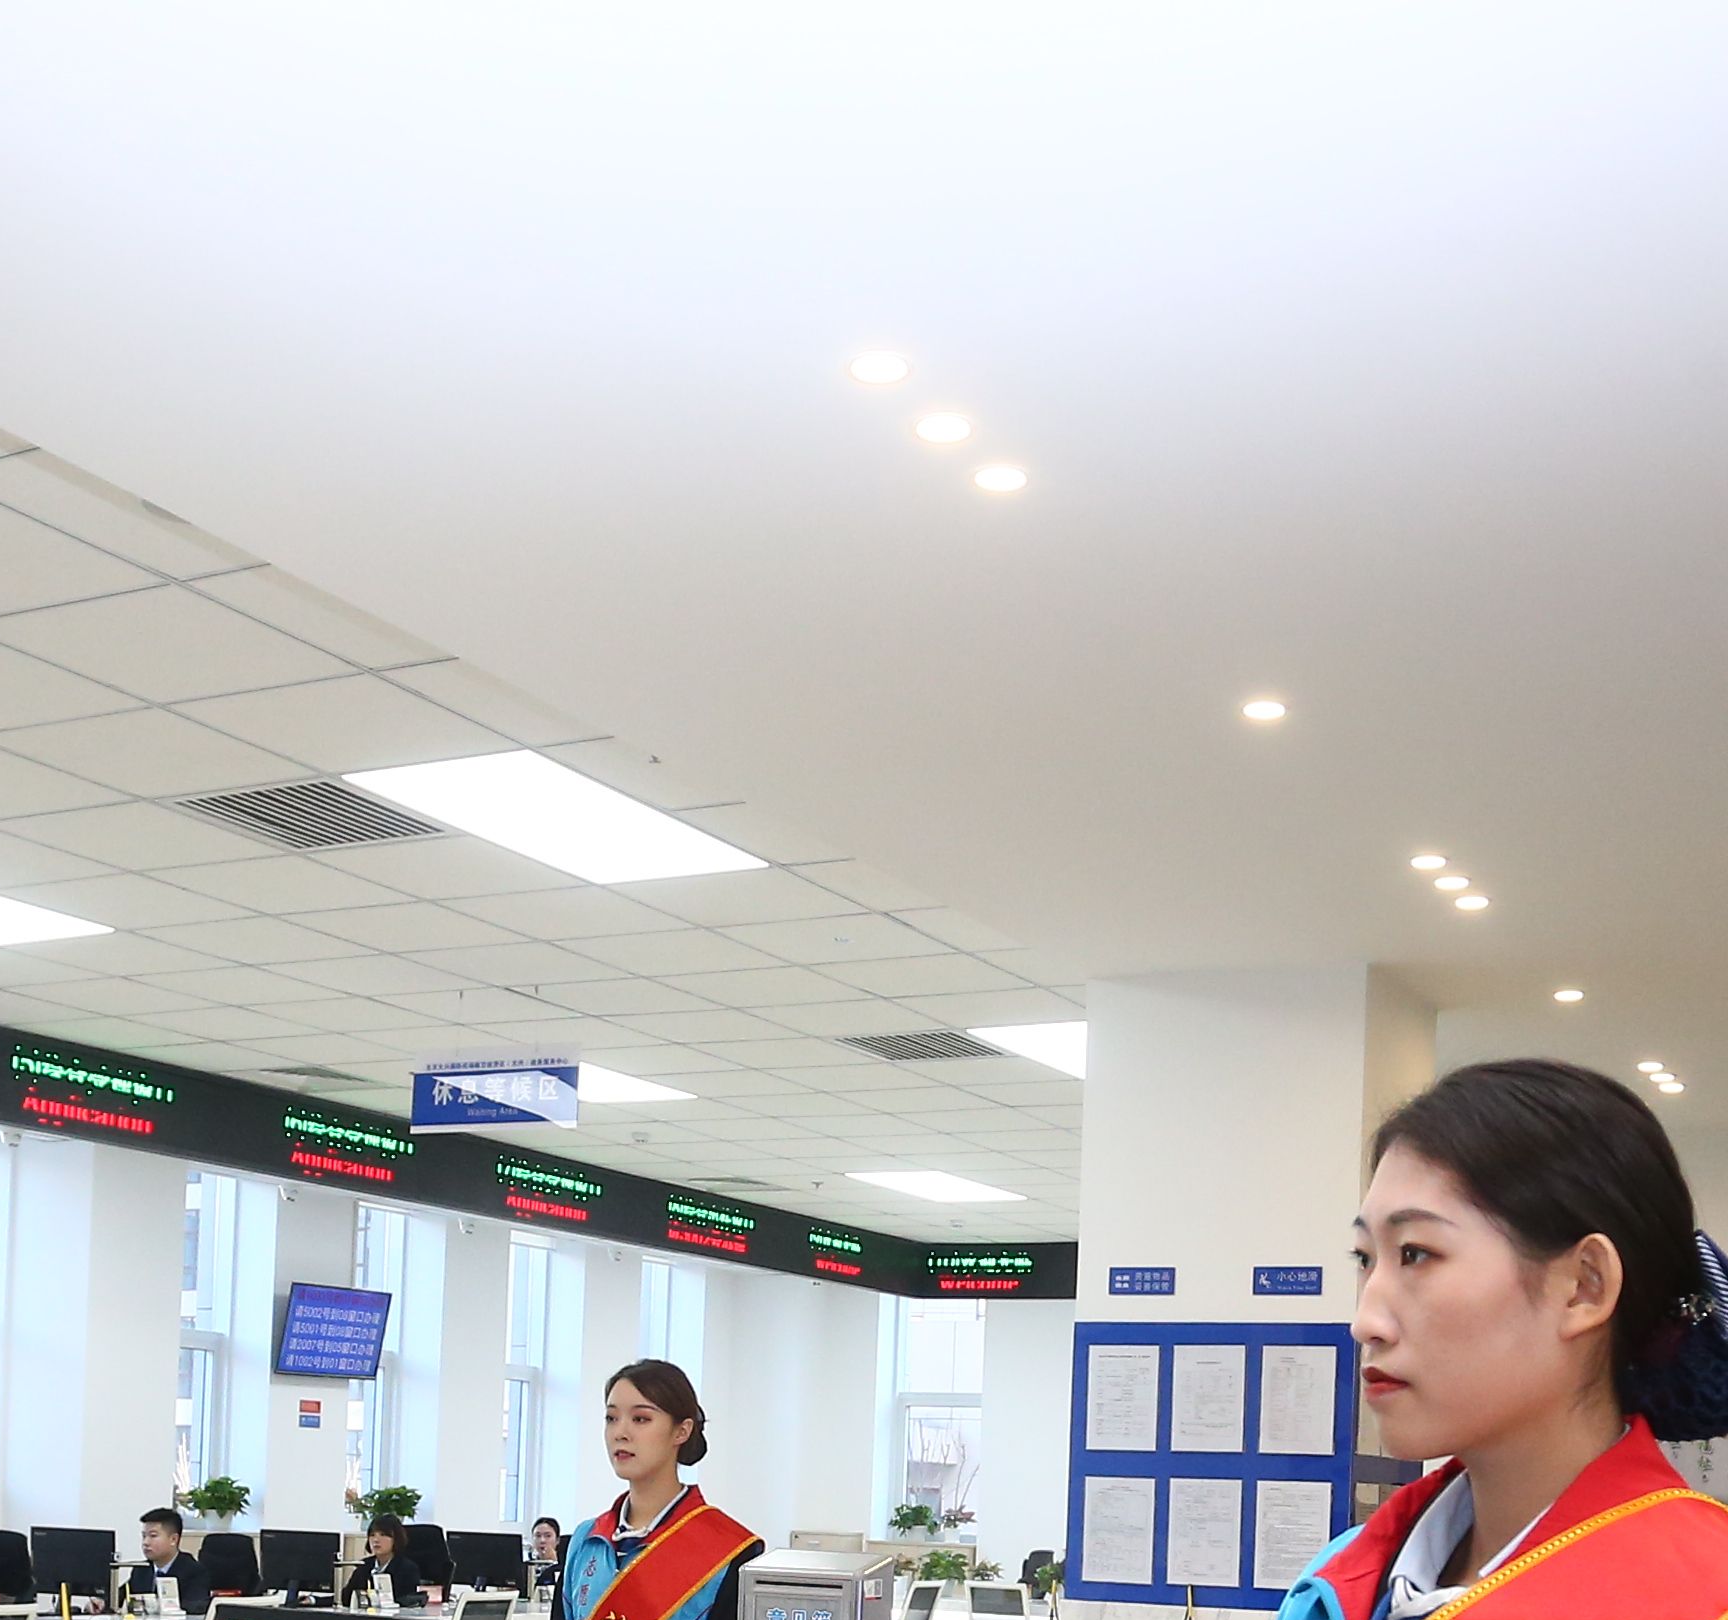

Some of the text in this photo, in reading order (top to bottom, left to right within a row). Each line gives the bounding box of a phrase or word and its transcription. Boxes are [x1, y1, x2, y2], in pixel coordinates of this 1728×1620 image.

[432, 1076, 560, 1106] 休息等候区
[1276, 1271, 1319, 1283] 小心地滑
